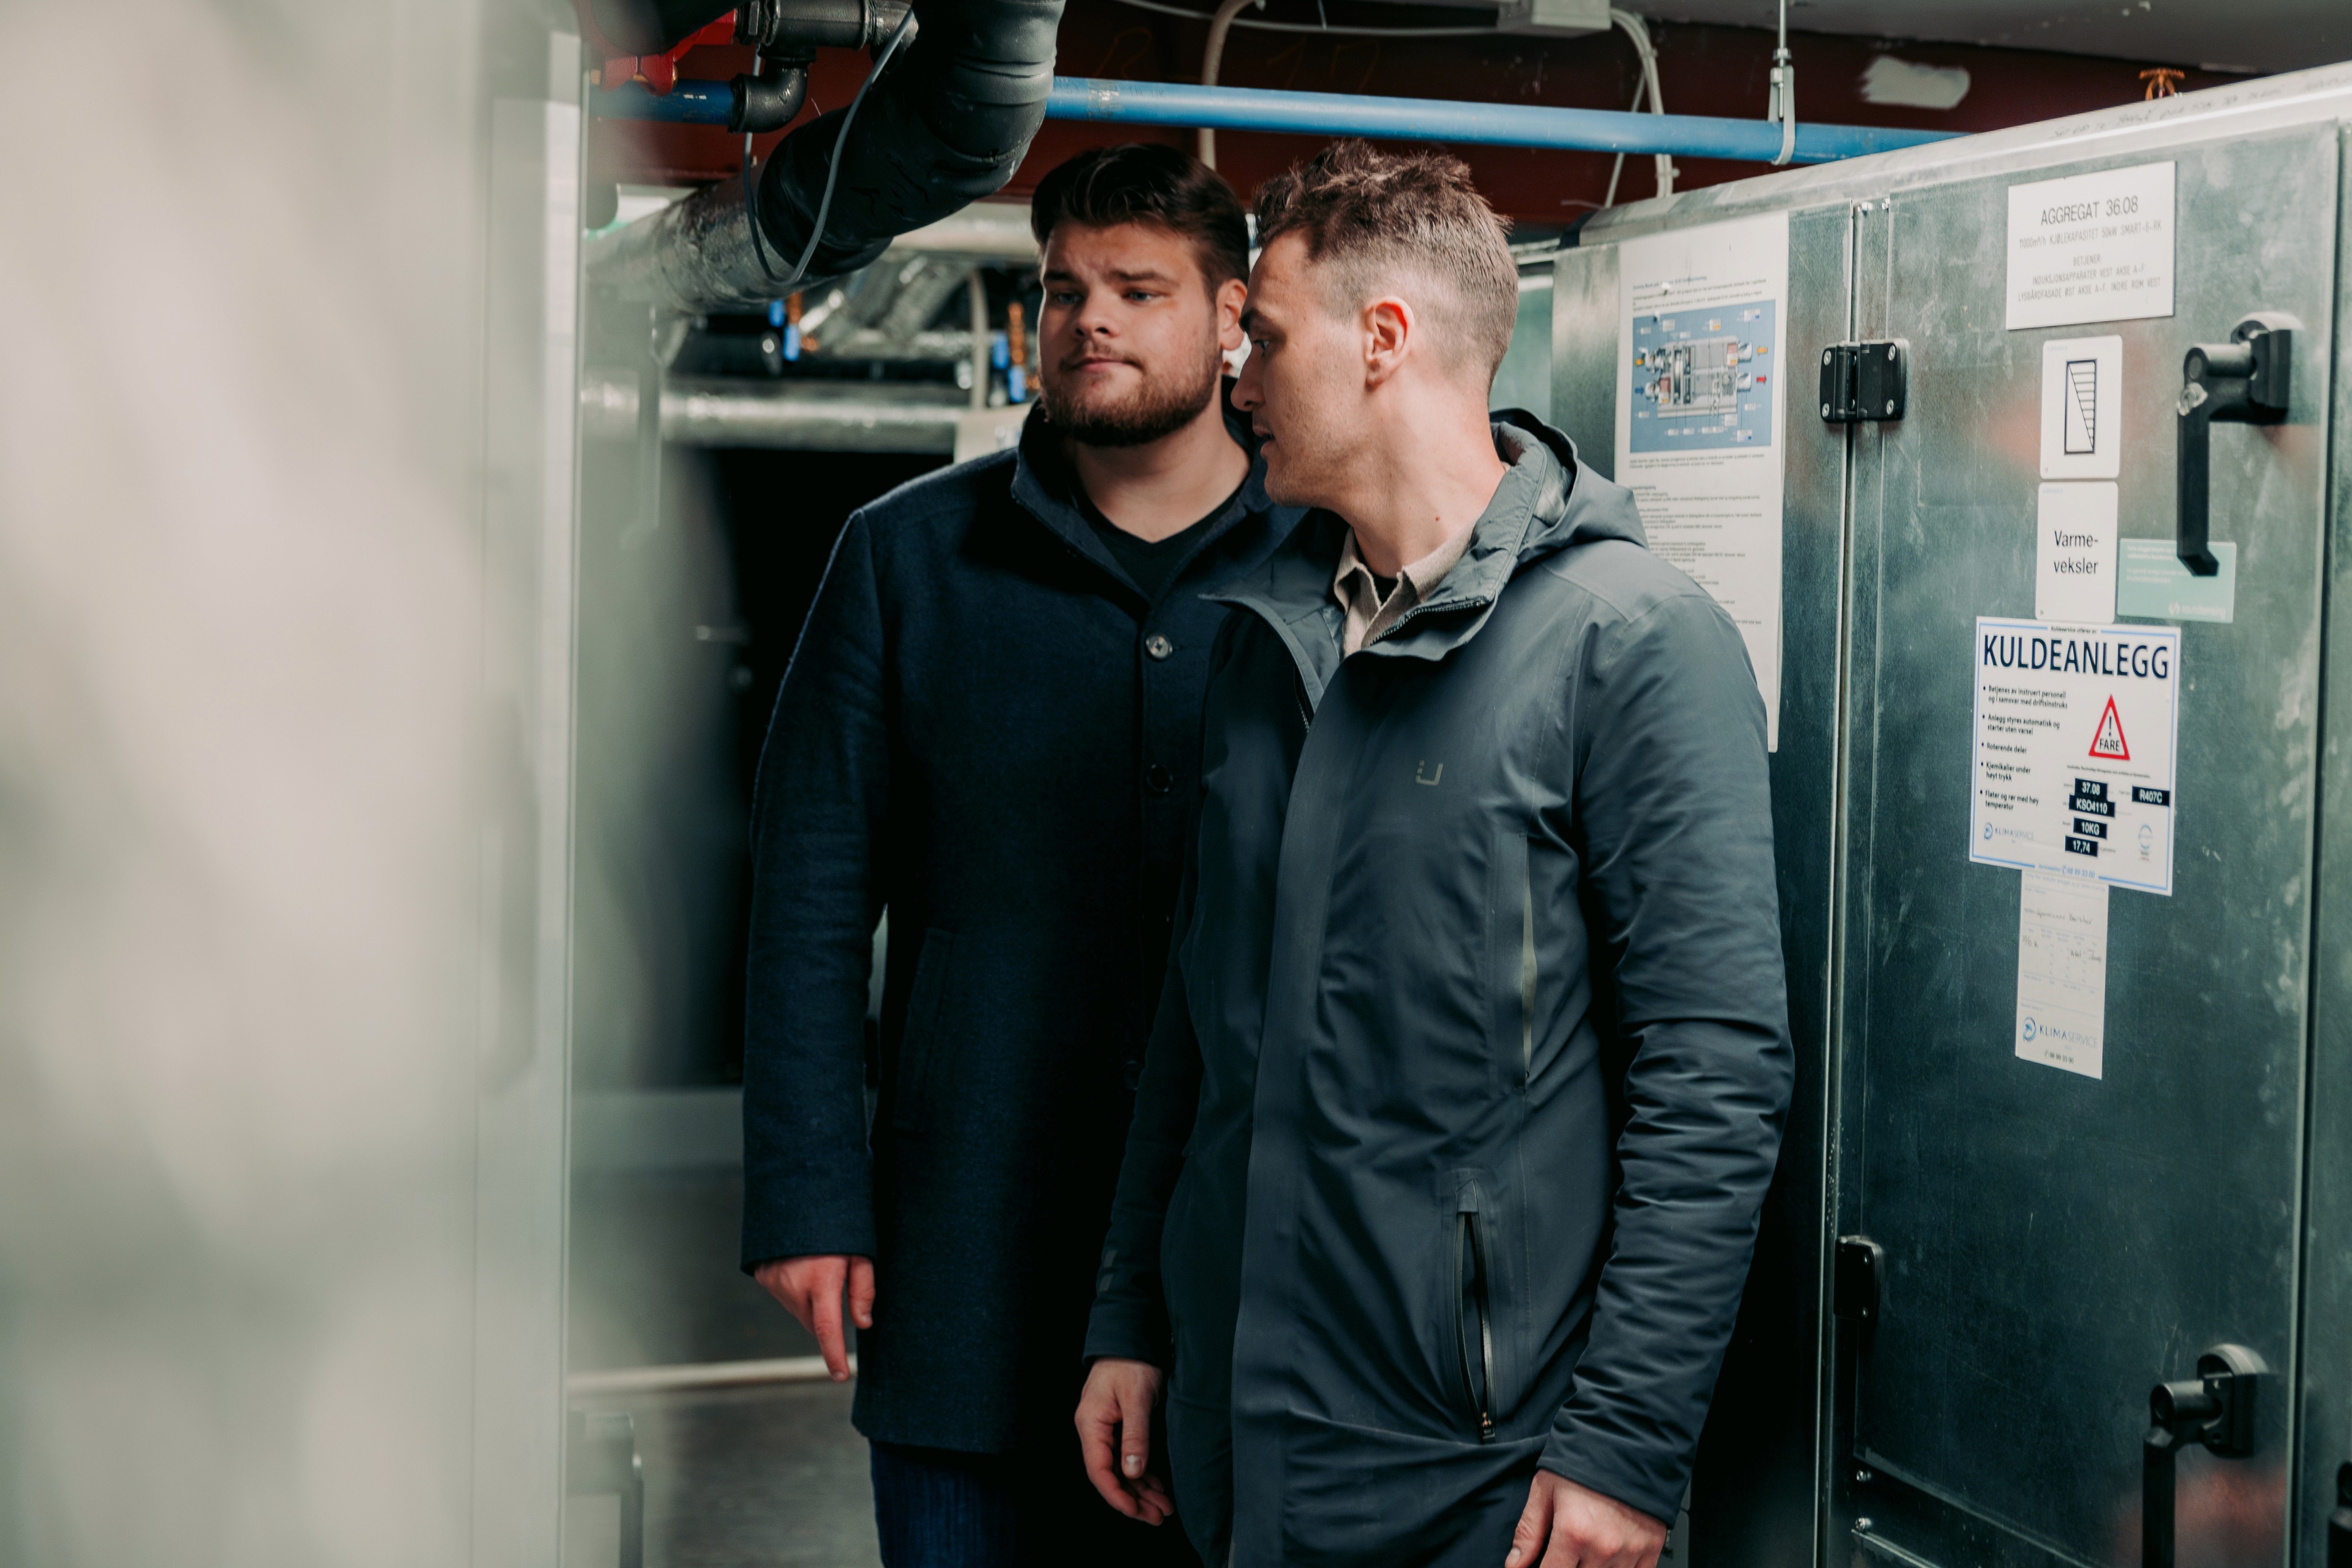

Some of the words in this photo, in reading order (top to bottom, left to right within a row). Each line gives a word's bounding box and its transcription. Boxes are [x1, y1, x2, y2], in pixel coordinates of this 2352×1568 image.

[2041, 202, 2099, 226] AGGREGAT
[2106, 195, 2138, 216] 36.08
[2100, 266, 2113, 278] VEST
[2115, 265, 2130, 276] AKSE
[2078, 284, 2092, 295] AKSE
[2111, 280, 2128, 292] INDRE
[2131, 278, 2144, 290] ROM
[2147, 276, 2161, 288] VEST
[2054, 531, 2099, 547] Varme-
[2054, 557, 2099, 574] veksler
[1984, 634, 2168, 679] KULDEANLEGG
[1989, 686, 2010, 695] Betjenes
[2018, 687, 2040, 696] instruert
[2041, 691, 2067, 699] personell
[2033, 699, 2068, 709] driftsinstruks
[1988, 714, 2006, 723] Anlegg
[2007, 717, 2022, 725] styres
[2023, 718, 2052, 727] automatisk
[1987, 742, 2013, 752] Roterende
[2014, 745, 2027, 753] deler
[2099, 738, 2121, 752] FARE
[1986, 761, 2014, 771] Kjemikalier
[2016, 765, 2031, 774] under
[1986, 771, 1998, 781] høyt
[1998, 773, 2012, 783] trykk
[1985, 789, 1999, 798] Flater
[2001, 793, 2007, 802] og
[2017, 794, 2028, 803] med
[2029, 796, 2039, 806] høy
[2140, 789, 2163, 804] R407C
[1986, 800, 2014, 810] temperatur
[1995, 827, 2035, 841] KLIMASERVICE
[2081, 821, 2100, 836] 10KG
[2073, 839, 2090, 854] 17,74
[2088, 870, 2095, 879] 00
[2040, 1024, 2098, 1049] KLIMASERVICE
